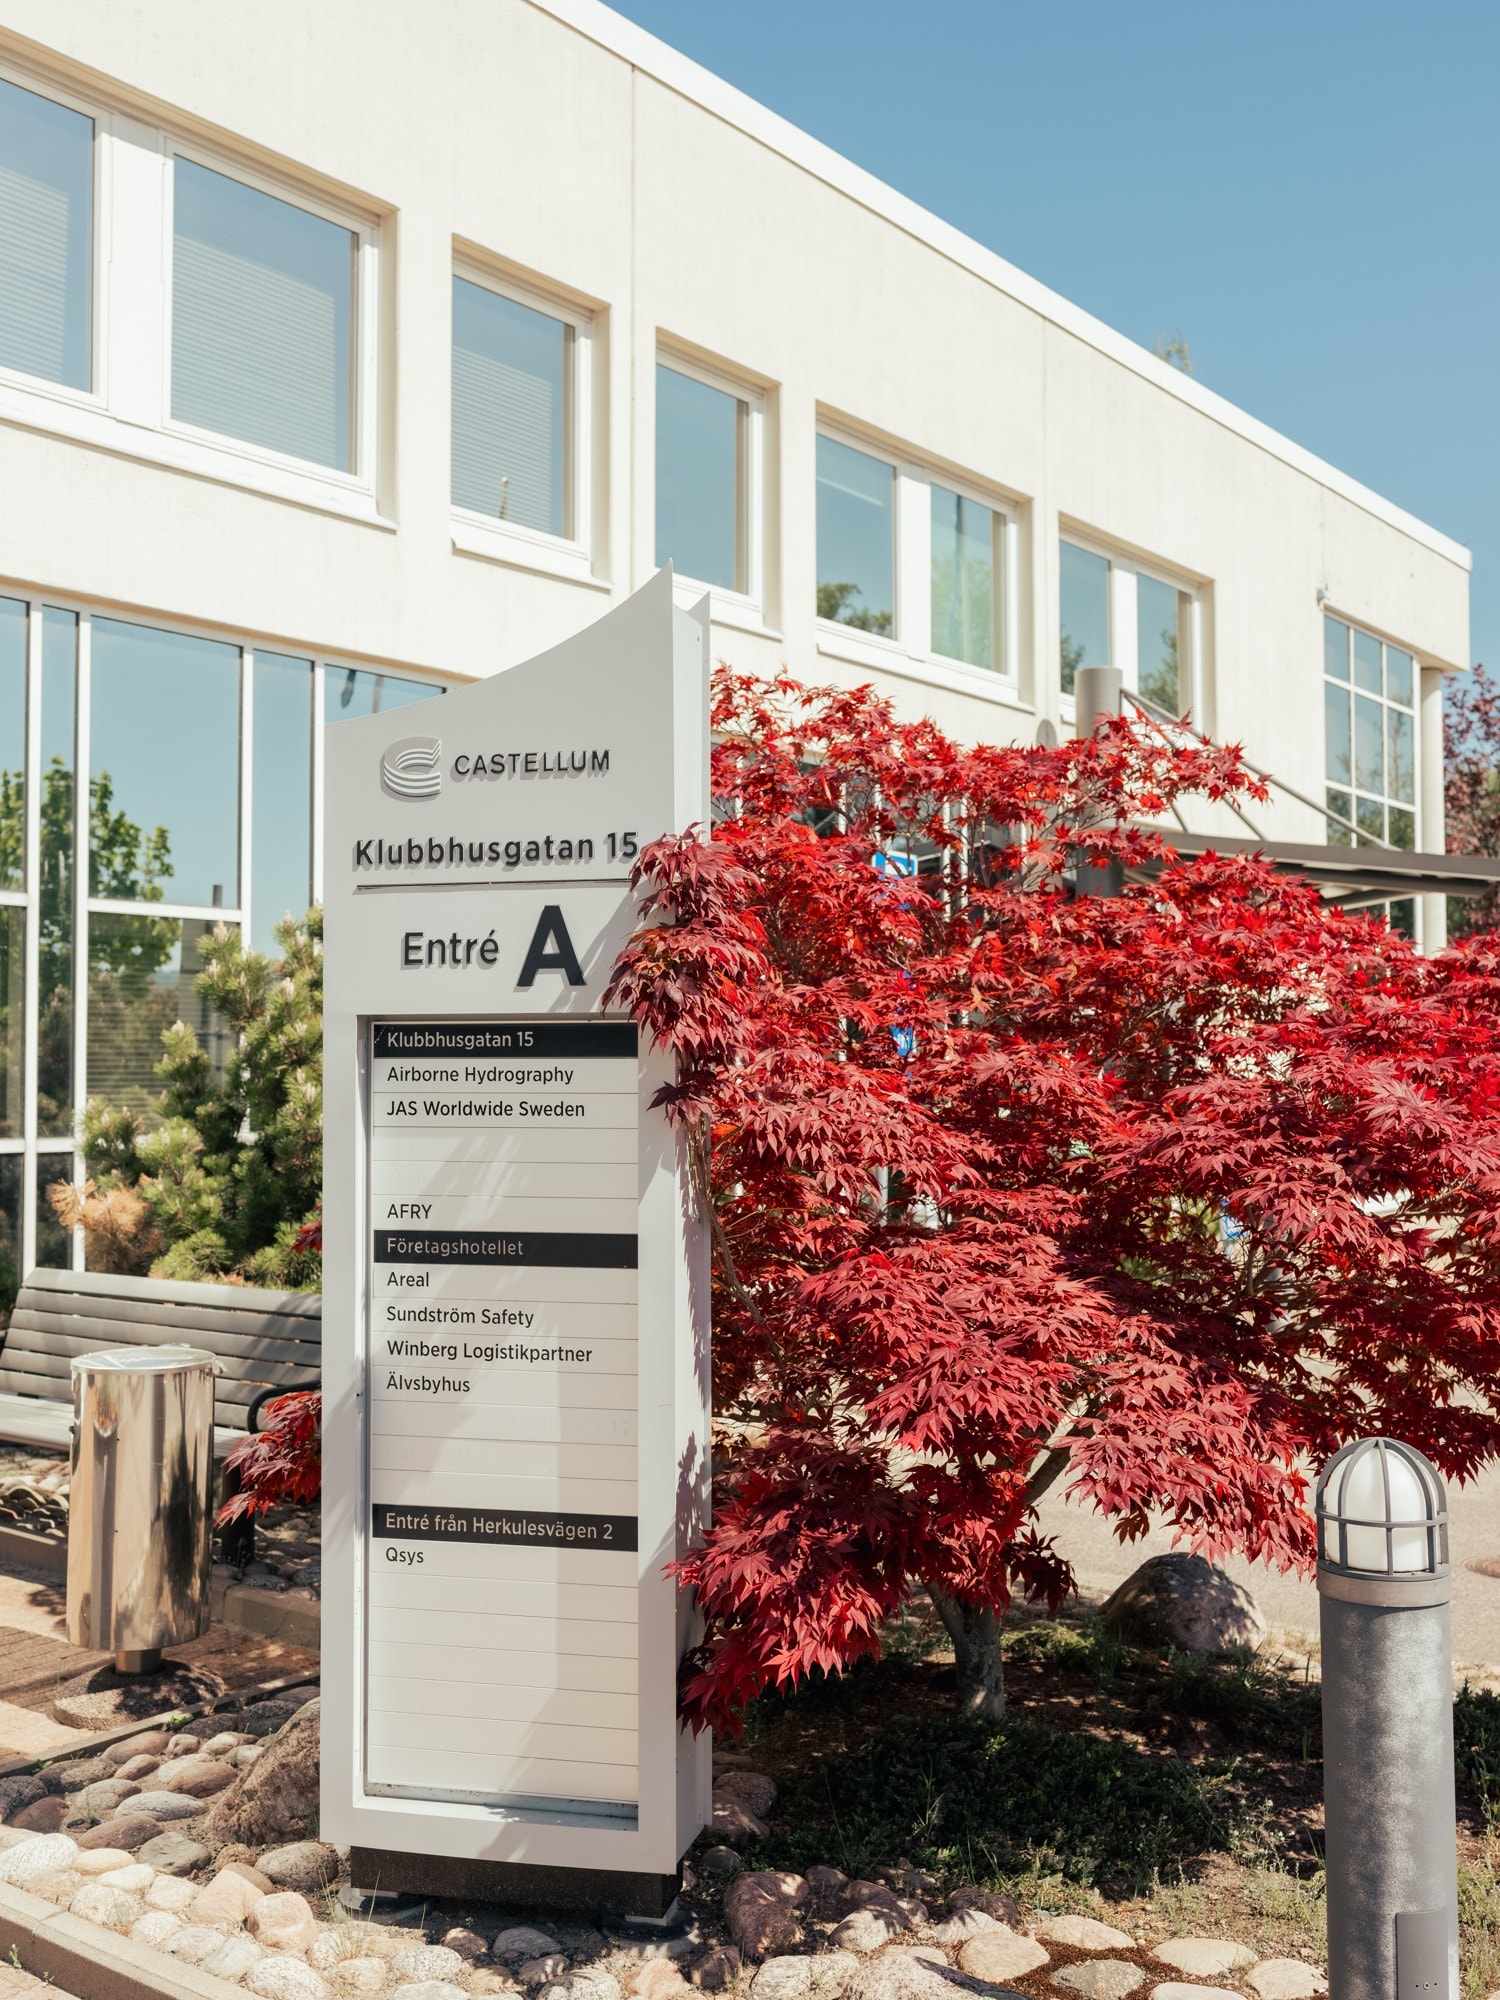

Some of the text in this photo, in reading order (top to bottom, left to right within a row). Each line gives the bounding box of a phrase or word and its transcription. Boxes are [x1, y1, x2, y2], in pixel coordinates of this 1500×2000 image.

[454, 750, 610, 774] CASTELLUM
[356, 832, 638, 866] Klubbhusgatan 15
[404, 905, 587, 986] Entré A
[387, 1032, 534, 1049] Klubbhusgatan 15
[387, 1066, 574, 1084] Airborne Hydrography
[387, 1101, 585, 1116] JAS Worldwide Sweden
[387, 1204, 432, 1219] AFRY
[387, 1238, 523, 1257] Företagshotellet
[387, 1272, 429, 1287] Areal
[387, 1306, 534, 1328] Sundström Safety
[387, 1341, 592, 1363] Winberg Logistikpartner
[386, 1372, 470, 1393] Älvsbyhus
[386, 1513, 613, 1540] Entré från Herkulesvägen 2
[386, 1548, 424, 1565] Qsys
